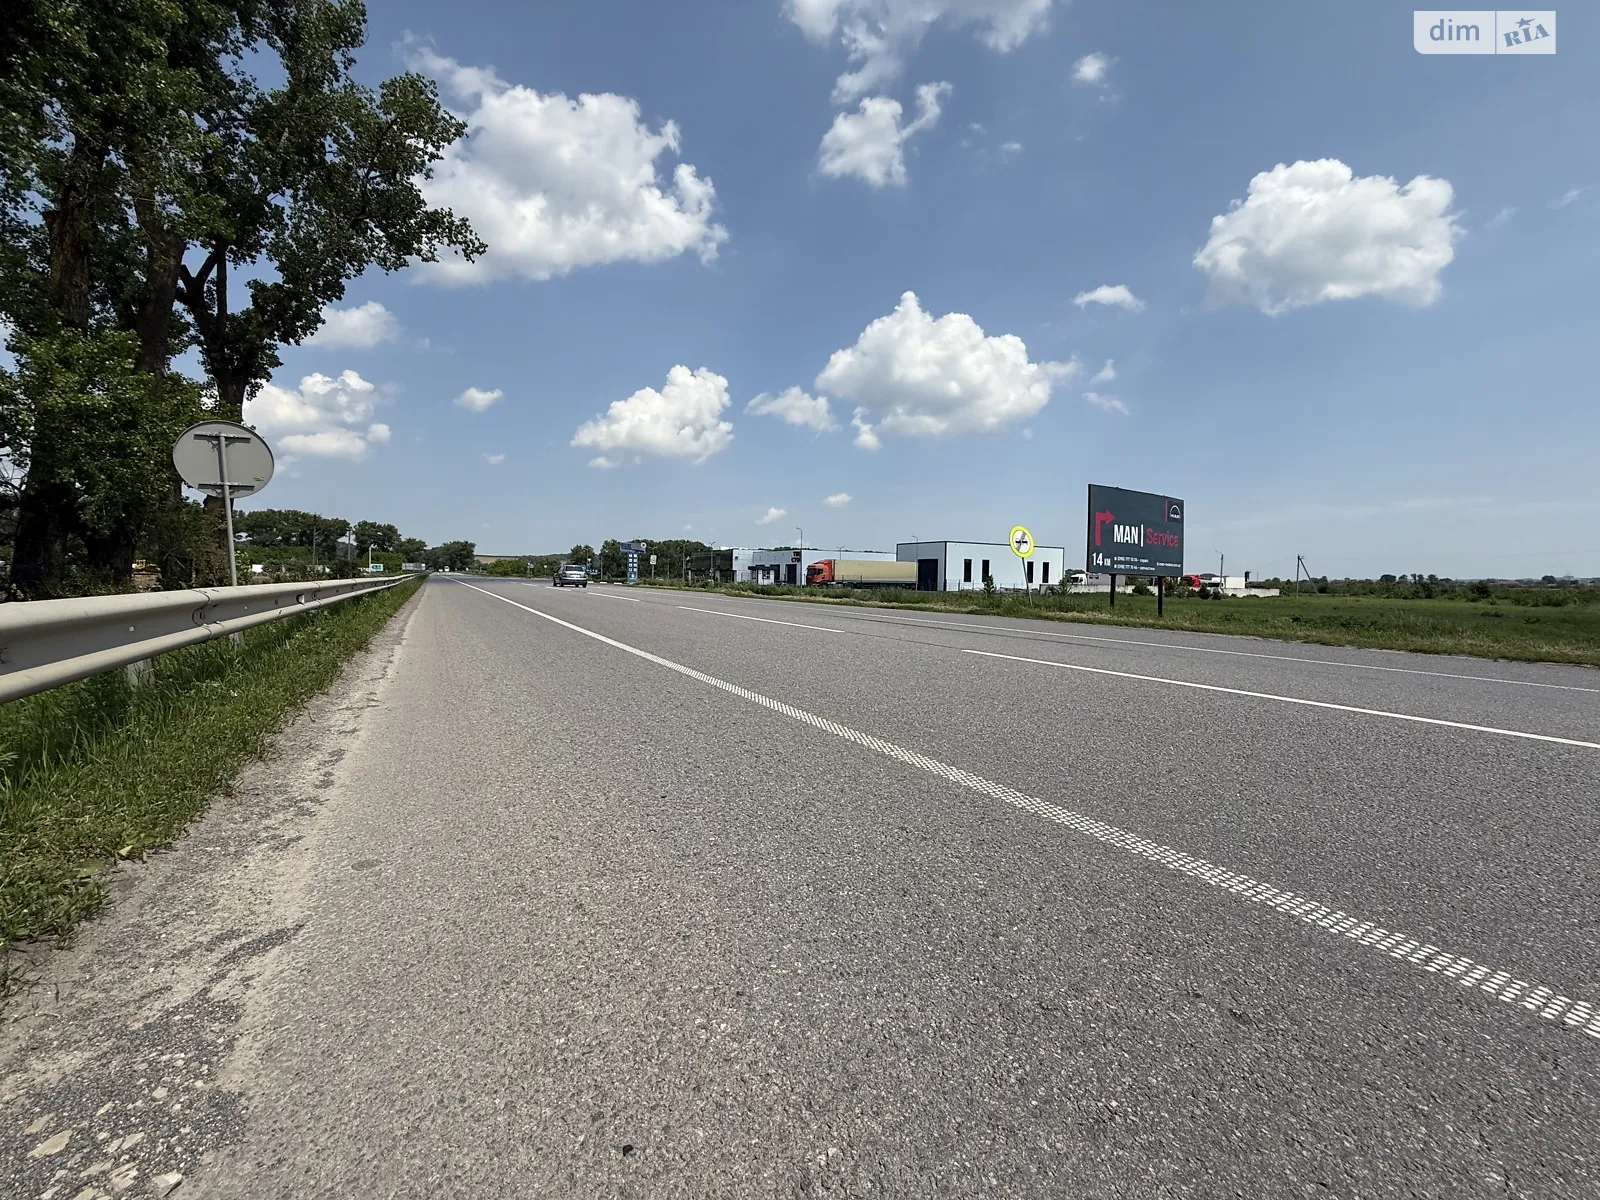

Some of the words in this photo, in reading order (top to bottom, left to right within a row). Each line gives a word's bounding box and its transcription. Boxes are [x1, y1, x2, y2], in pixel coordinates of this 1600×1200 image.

[1113, 524, 1139, 545] MAN
[1146, 527, 1179, 548] Service
[1092, 552, 1103, 566] 14
